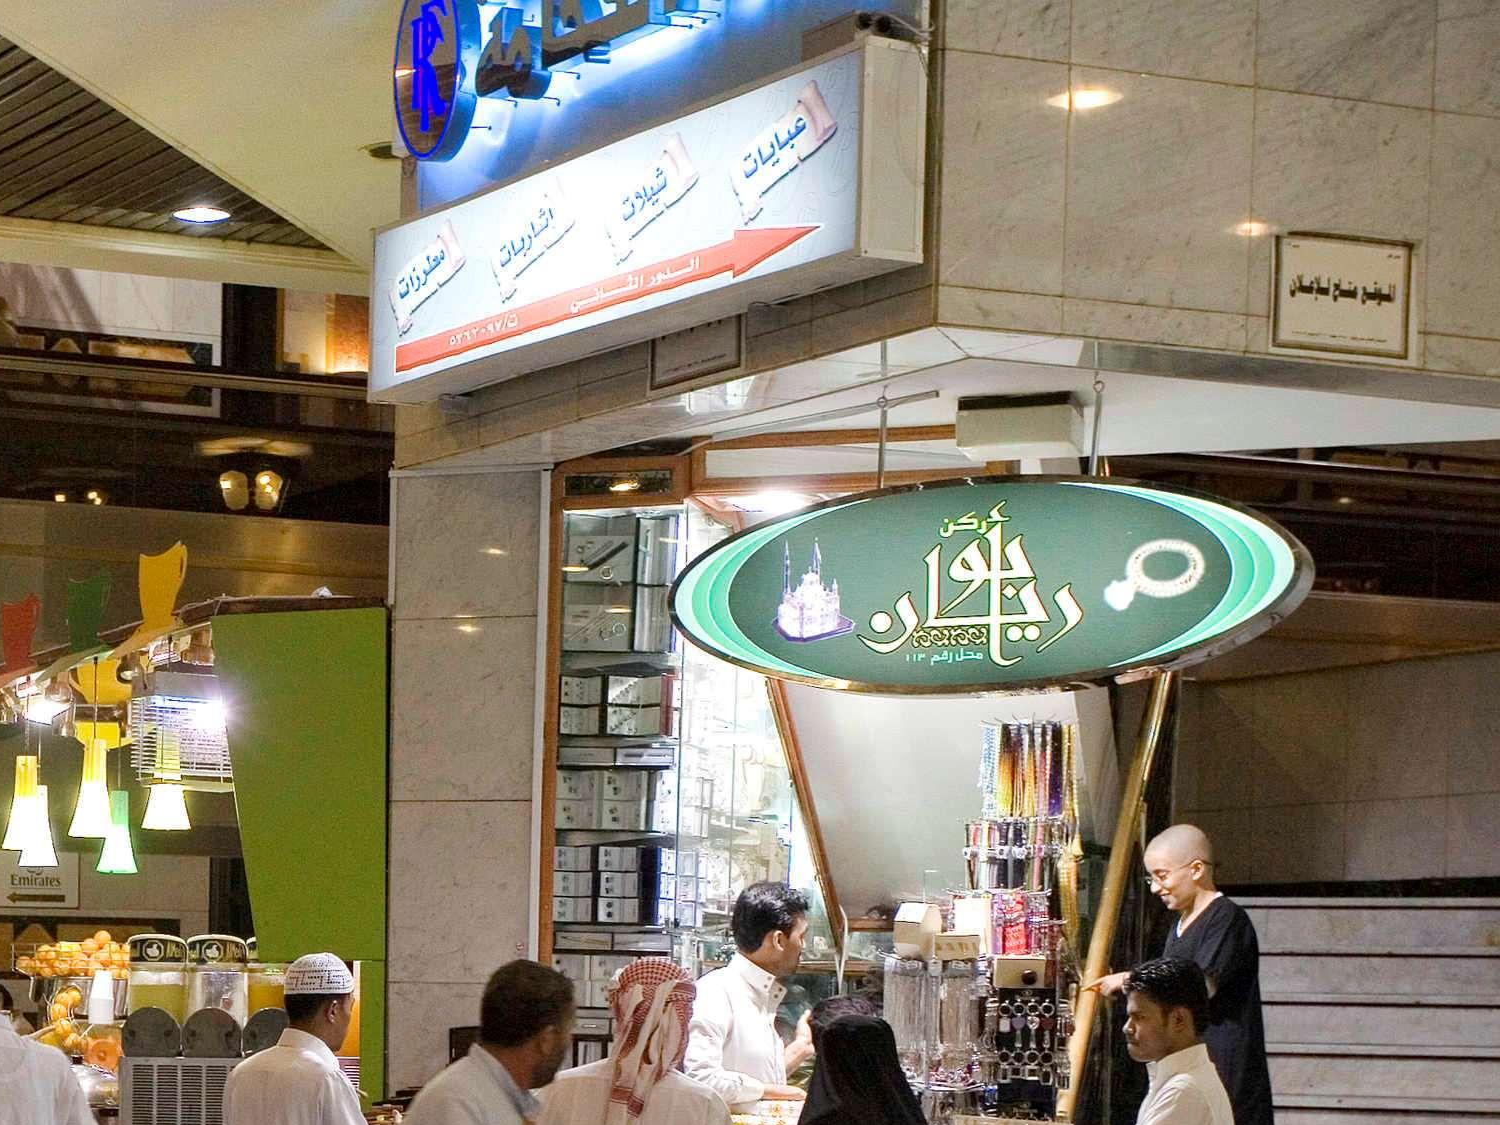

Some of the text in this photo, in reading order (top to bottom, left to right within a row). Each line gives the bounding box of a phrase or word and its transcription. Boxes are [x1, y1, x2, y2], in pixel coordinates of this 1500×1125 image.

[743, 116, 806, 178] عبايات
[621, 166, 668, 221] شيلات
[398, 249, 445, 299] مطرزات
[570, 256, 700, 314] الدور الثاني
[1332, 278, 1357, 302] متاح
[1361, 282, 1396, 306] الموقع
[930, 650, 953, 666] رقم
[955, 648, 984, 662] محل
[10, 874, 61, 887] Emirates
